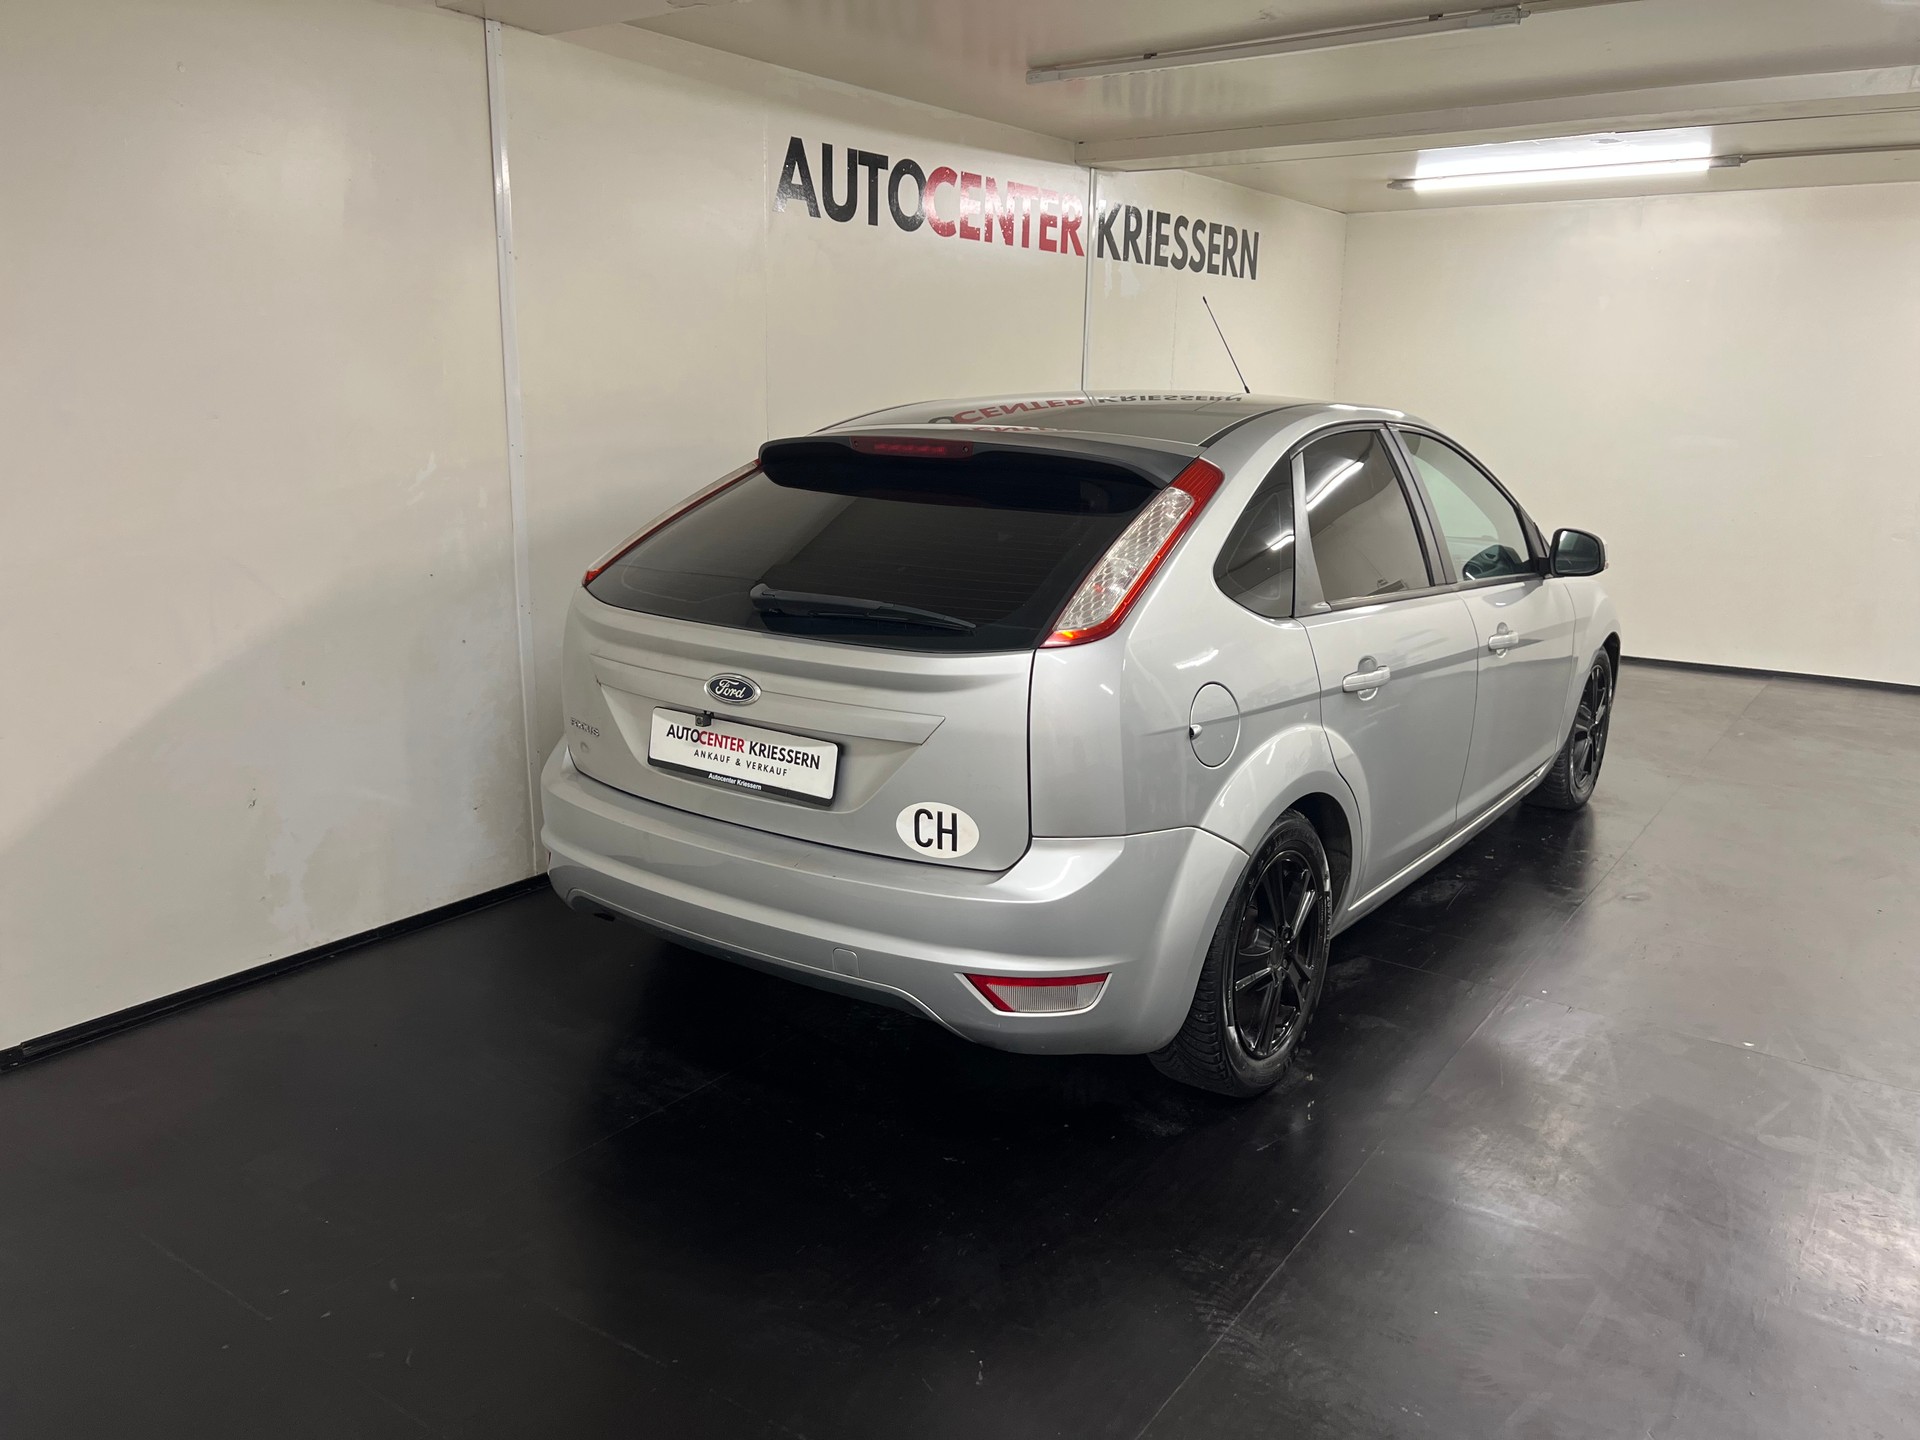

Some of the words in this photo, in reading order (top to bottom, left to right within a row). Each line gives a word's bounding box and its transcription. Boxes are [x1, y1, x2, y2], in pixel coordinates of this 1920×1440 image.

[773, 136, 1085, 257] AUTOCENTER
[1096, 200, 1260, 280] KRIESSERN
[715, 679, 746, 699] Ford
[666, 724, 745, 754] AUTOCENTER
[749, 740, 821, 770] KRIESSERN
[693, 749, 731, 764] ANKAUF
[735, 757, 741, 766] &
[745, 760, 788, 777] VERKAUF
[708, 772, 737, 785] Autocenter
[736, 779, 762, 791] Kriessern
[913, 808, 958, 852] CH
